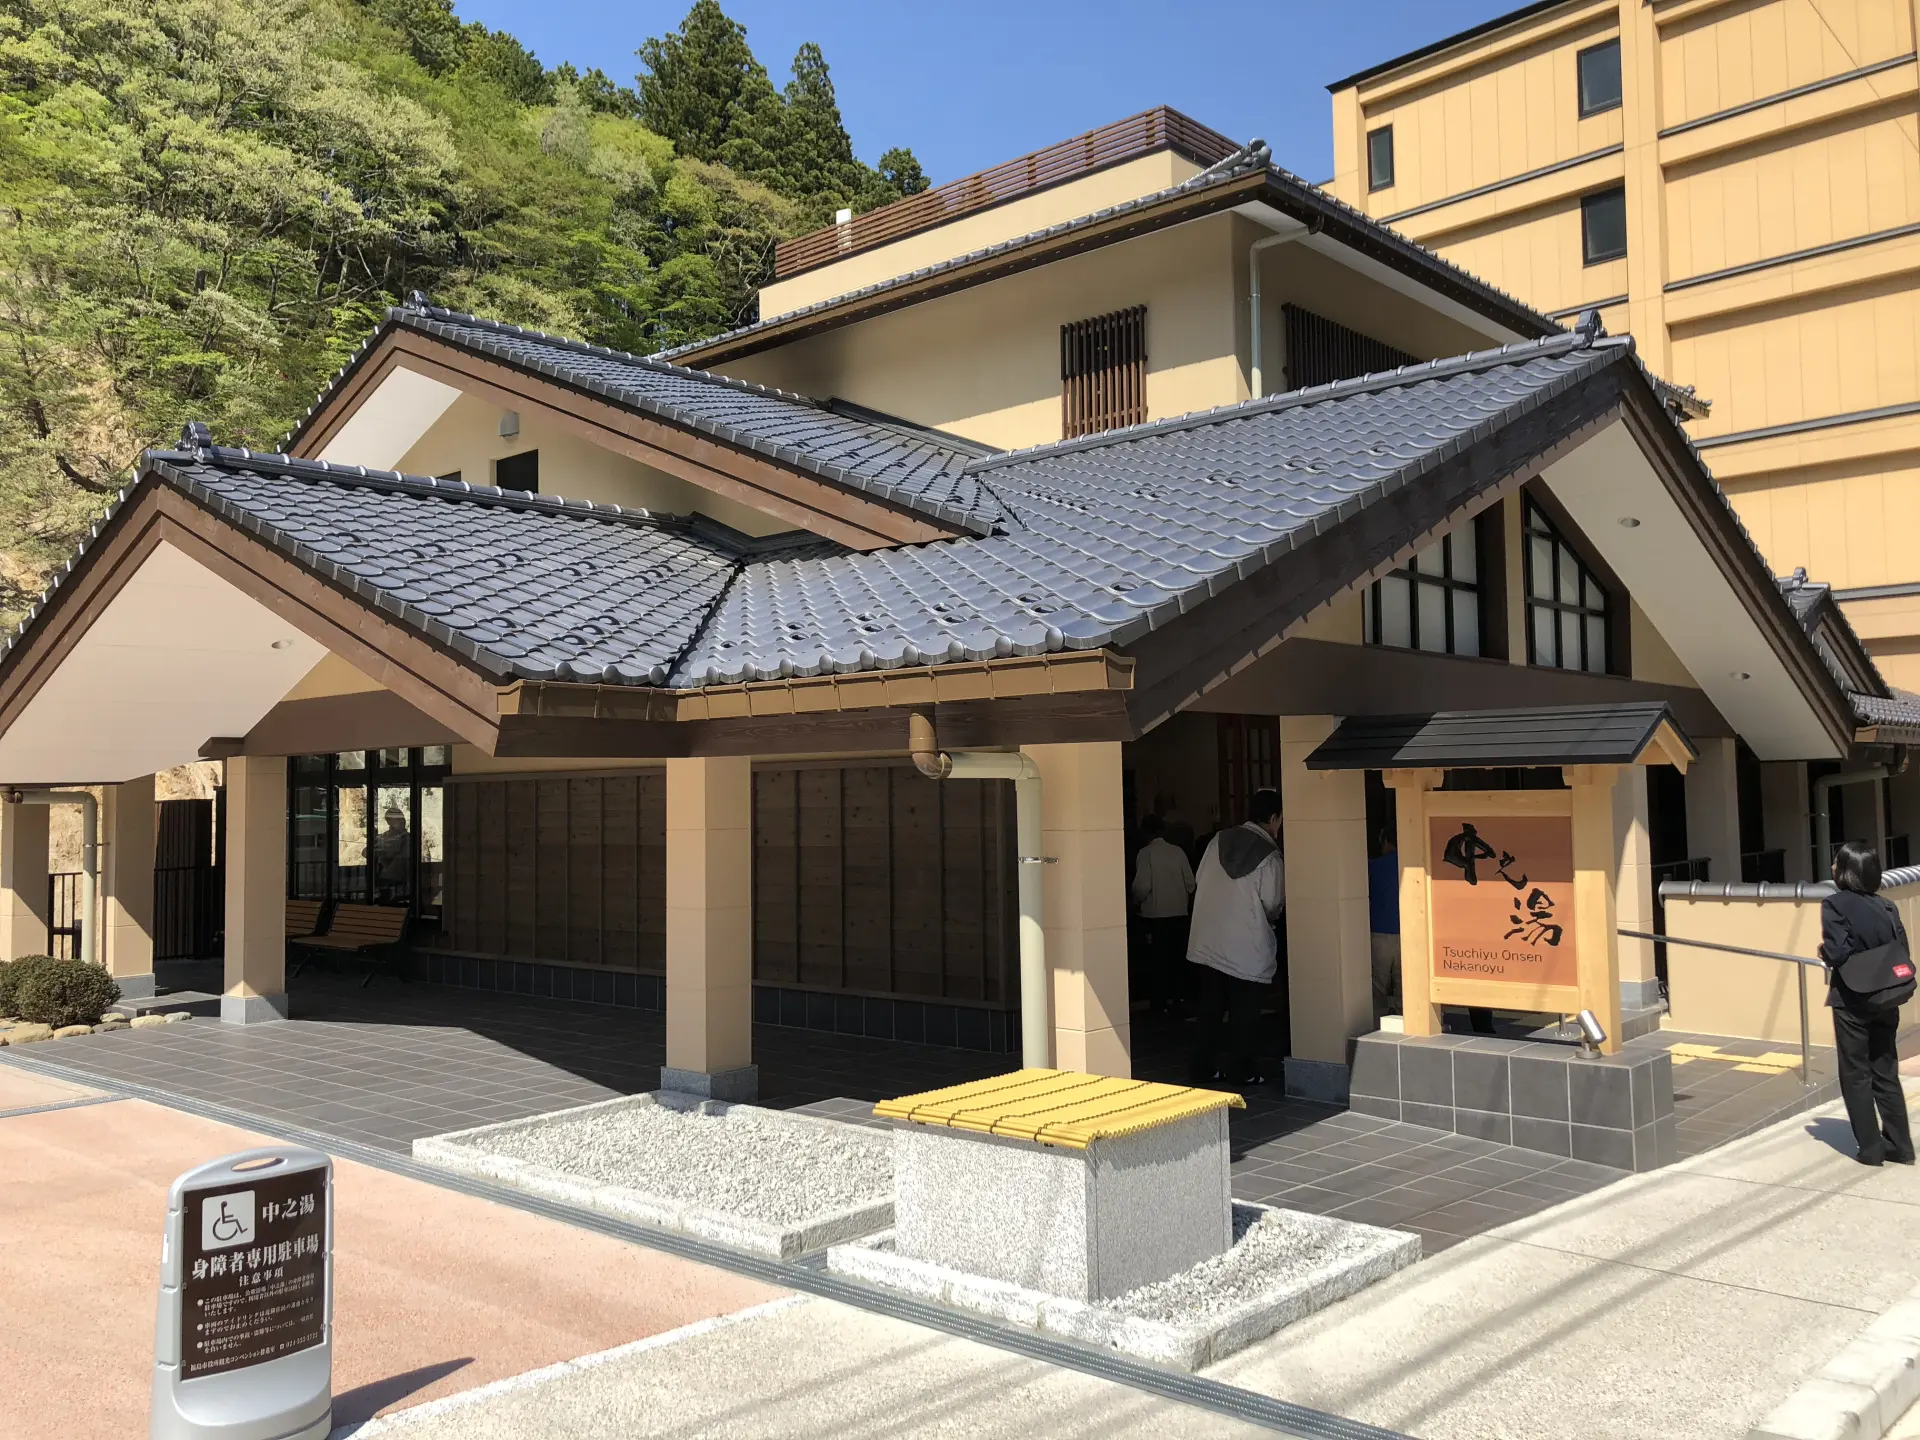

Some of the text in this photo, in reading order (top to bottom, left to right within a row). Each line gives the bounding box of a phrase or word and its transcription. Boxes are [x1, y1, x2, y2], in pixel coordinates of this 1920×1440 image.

[1442, 946, 1542, 962] Tsuchiyu Onsen
[1443, 960, 1504, 974] Nakanoyu
[262, 1193, 315, 1223] 中之湯
[192, 1233, 319, 1280] 身障者専用駐車場
[239, 1266, 284, 1287] 注意事項
